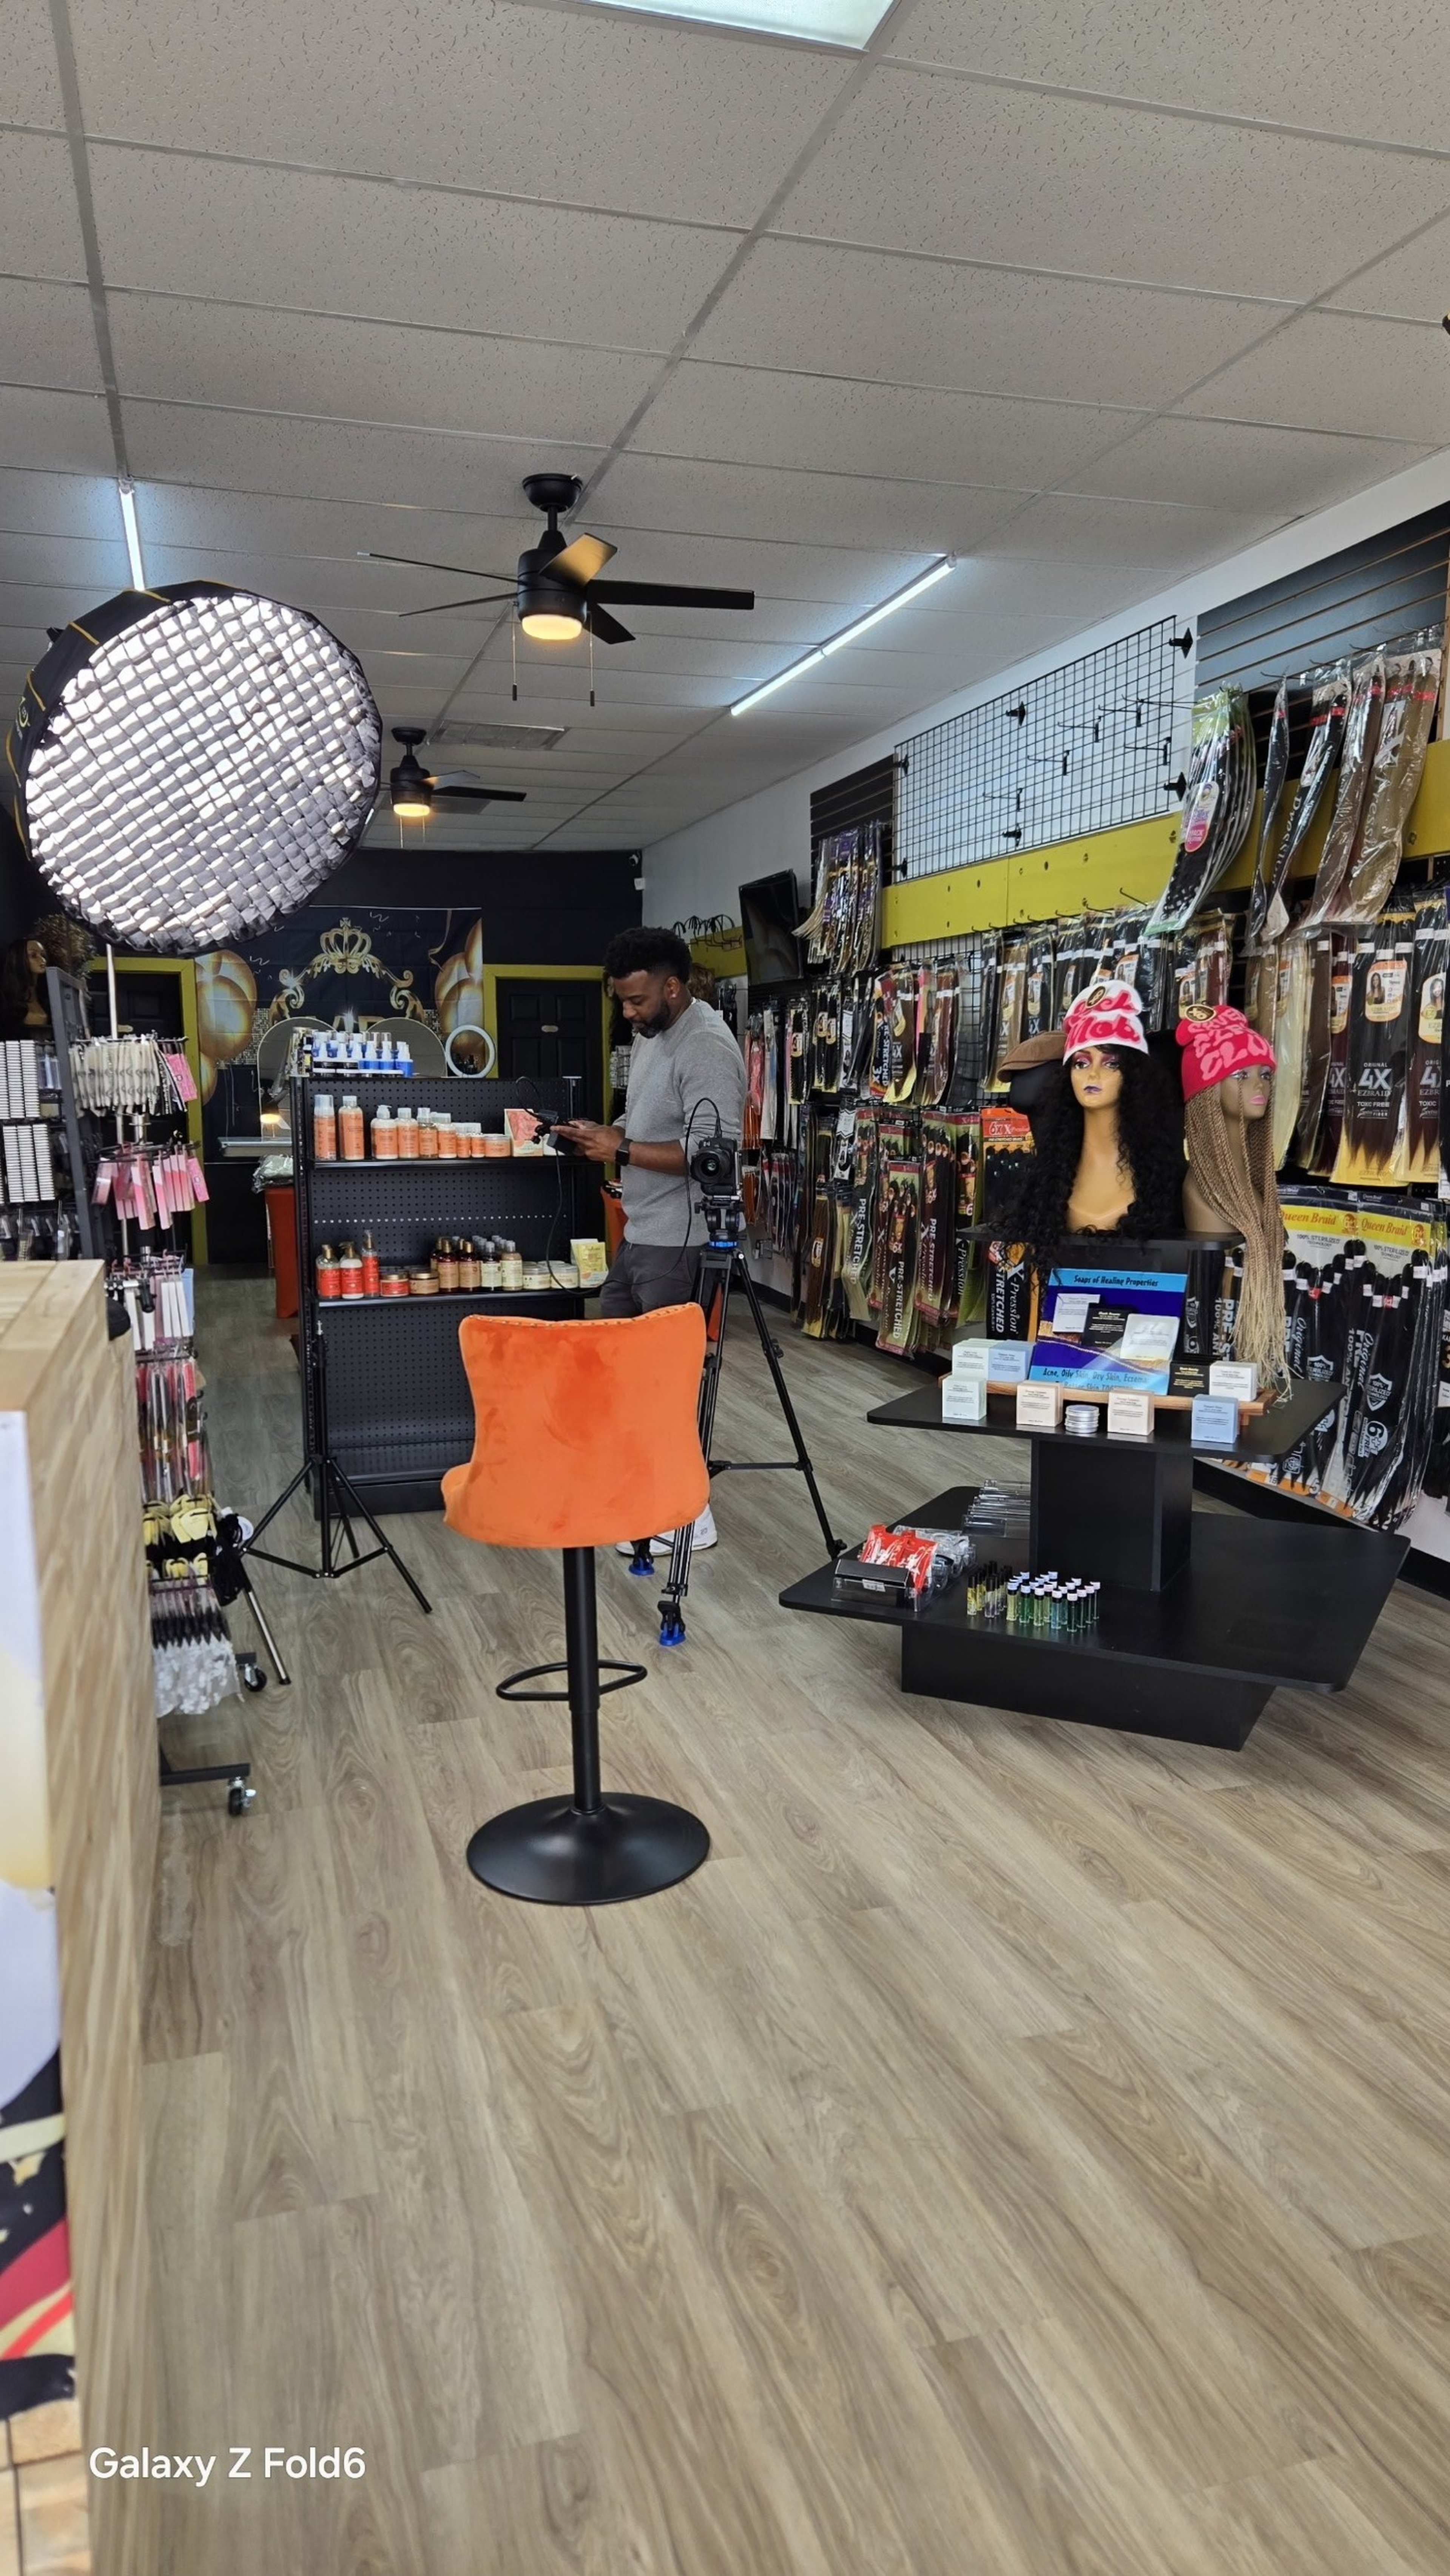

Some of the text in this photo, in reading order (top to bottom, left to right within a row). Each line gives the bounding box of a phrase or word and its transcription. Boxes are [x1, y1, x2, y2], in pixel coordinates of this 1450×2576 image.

[1358, 1068, 1392, 1090] 4X
[1310, 1212, 1337, 1226] Braid
[1361, 1217, 1408, 1236] Queen Braid
[1310, 1235, 1340, 1245] STERILIZED
[1074, 1275, 1091, 1283] Soaps
[1100, 1276, 1124, 1286] Healing
[1125, 1277, 1159, 1287] Properties
[893, 1261, 905, 1339] PRE-STRETCHED
[1007, 1262, 1024, 1334] X-Pression
[1214, 1297, 1222, 1329] 100%
[1293, 1317, 1307, 1375] Original
[1357, 1332, 1374, 1392] Original
[1043, 1368, 1059, 1377] Acne,
[1061, 1369, 1074, 1379] Oily
[1092, 1371, 1103, 1381] Dry
